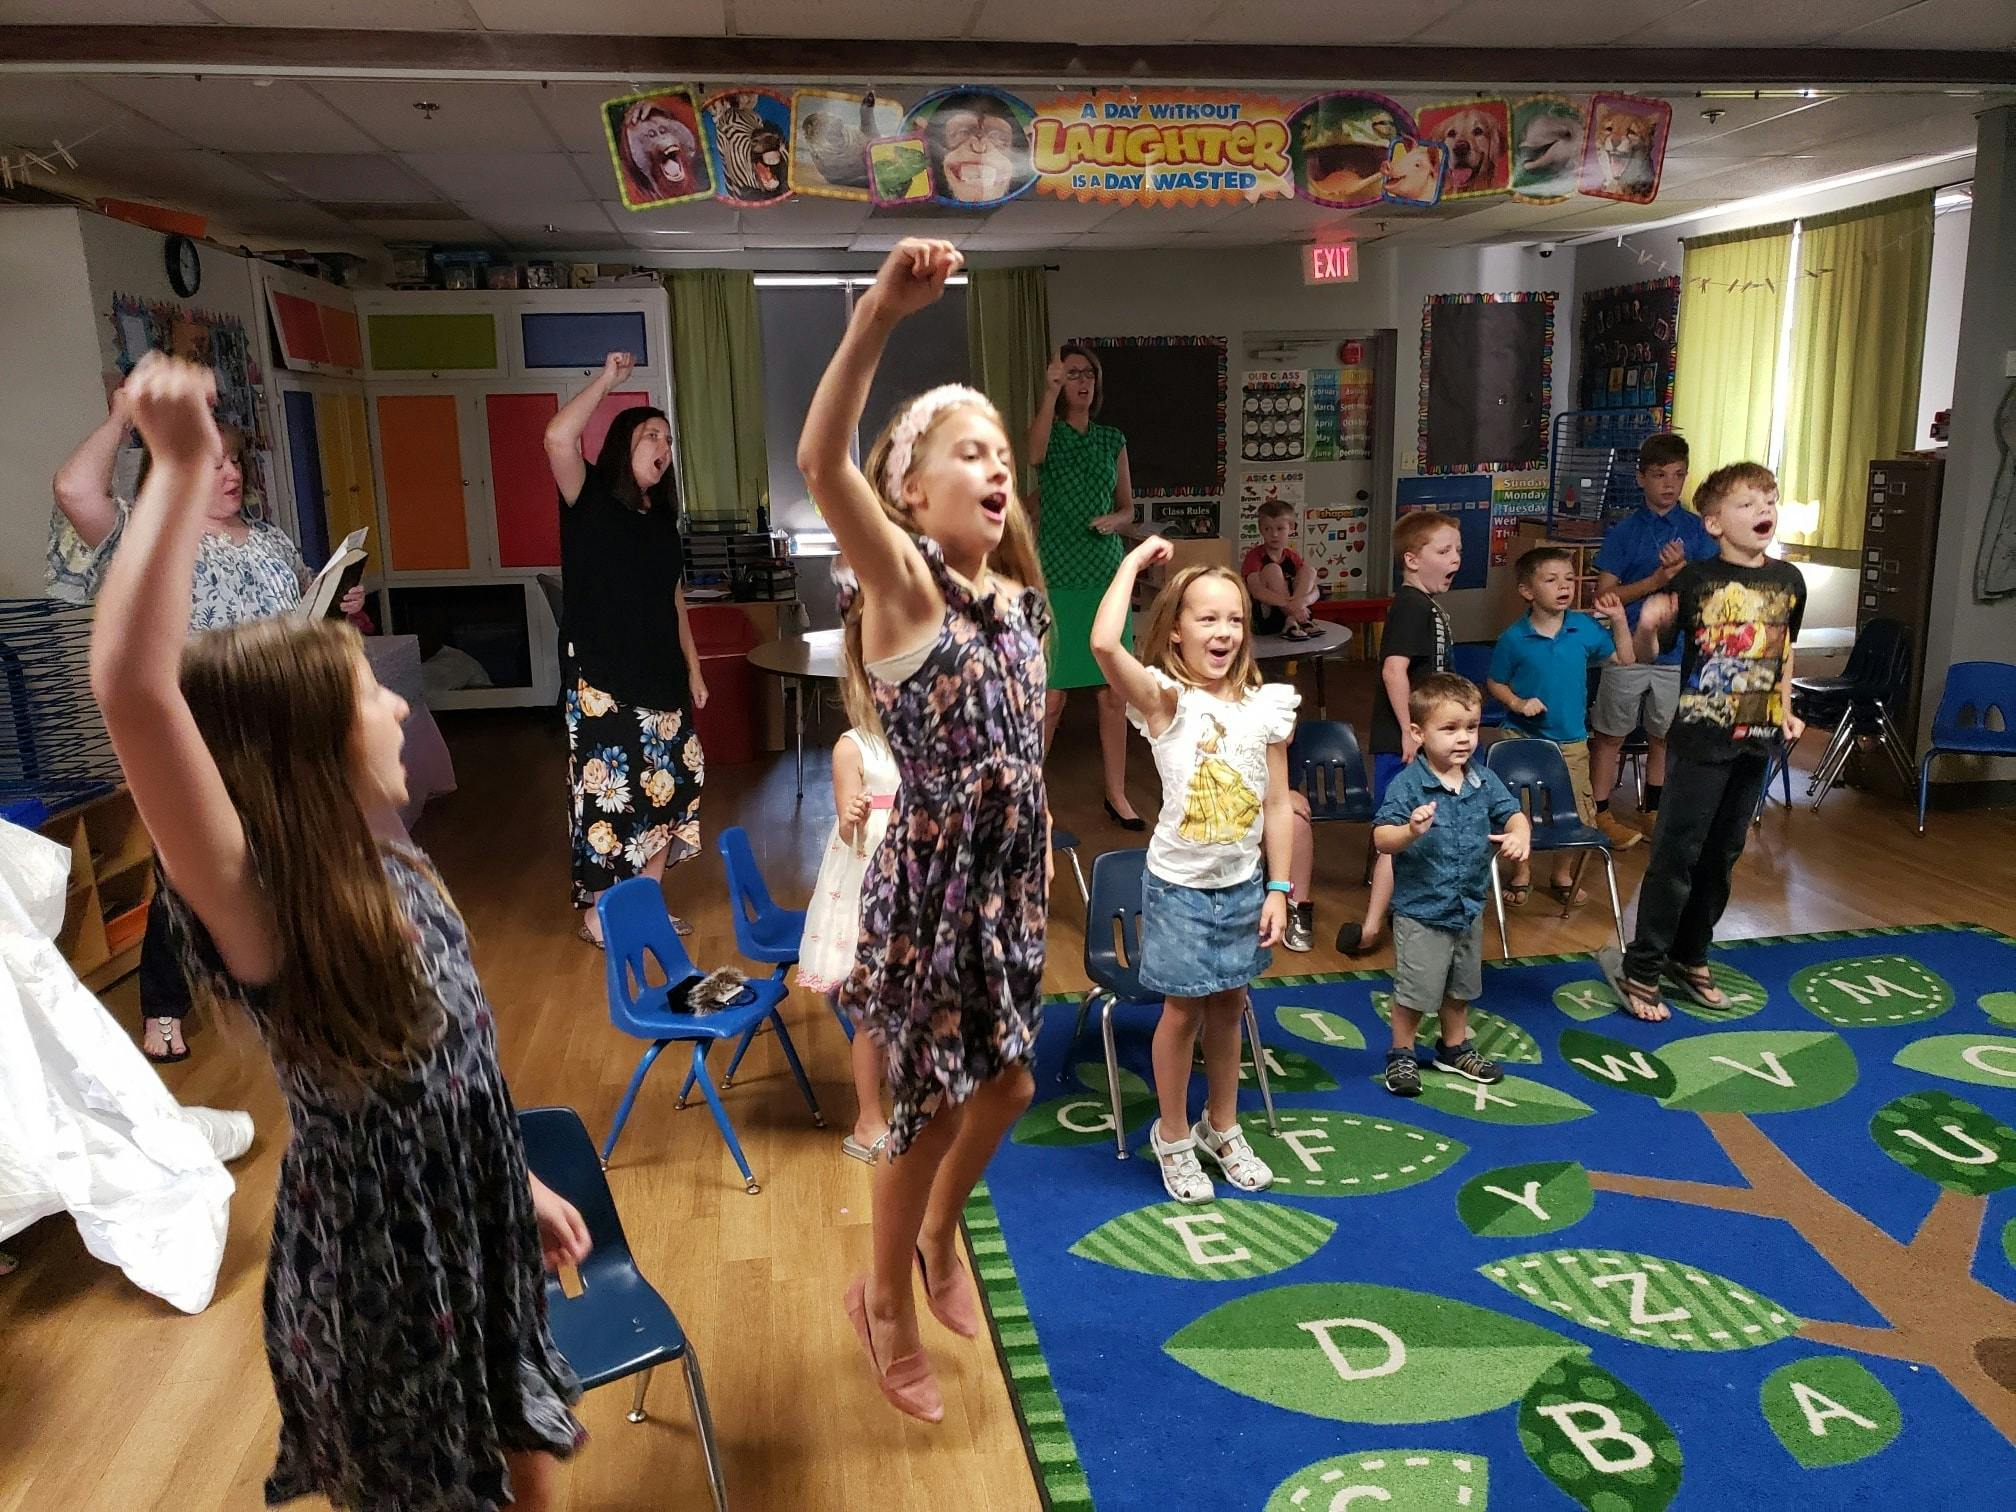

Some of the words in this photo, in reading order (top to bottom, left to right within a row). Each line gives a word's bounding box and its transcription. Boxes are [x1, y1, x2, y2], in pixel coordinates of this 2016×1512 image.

[1081, 103, 1097, 119] A
[1104, 103, 1141, 119] DAY
[1150, 103, 1240, 120] WITHOUT
[1033, 119, 1290, 176] LAUGHTER
[1072, 173, 1087, 187] IS
[1090, 175, 1101, 187] A
[1104, 172, 1144, 190] DAY
[1152, 171, 1257, 190] WASTED
[1313, 246, 1350, 279] EXIT
[1270, 371, 1300, 380] CASS
[1312, 403, 1335, 412] March
[1315, 419, 1333, 429] April
[1316, 434, 1331, 443] May
[1503, 479, 1547, 489] Sunday
[1503, 491, 1546, 501] Monday
[1162, 506, 1184, 516] Class
[1186, 506, 1210, 515] Rules
[1240, 513, 1261, 521] Purpl
[1503, 504, 1547, 514] Tuesday
[1829, 975, 1930, 1005] M
[1300, 1012, 1347, 1042] I
[1570, 1051, 1659, 1082] W
[1708, 1051, 1799, 1088] V
[1056, 1101, 1117, 1133] G
[1279, 1129, 1336, 1172] F
[1893, 1124, 2000, 1165] U
[1482, 1181, 1551, 1221] Y
[1162, 1213, 1252, 1265] E
[1591, 1271, 1692, 1325] Z
[1296, 1317, 1407, 1381] D
[1788, 1381, 1879, 1437] A
[1534, 1401, 1655, 1473] B
